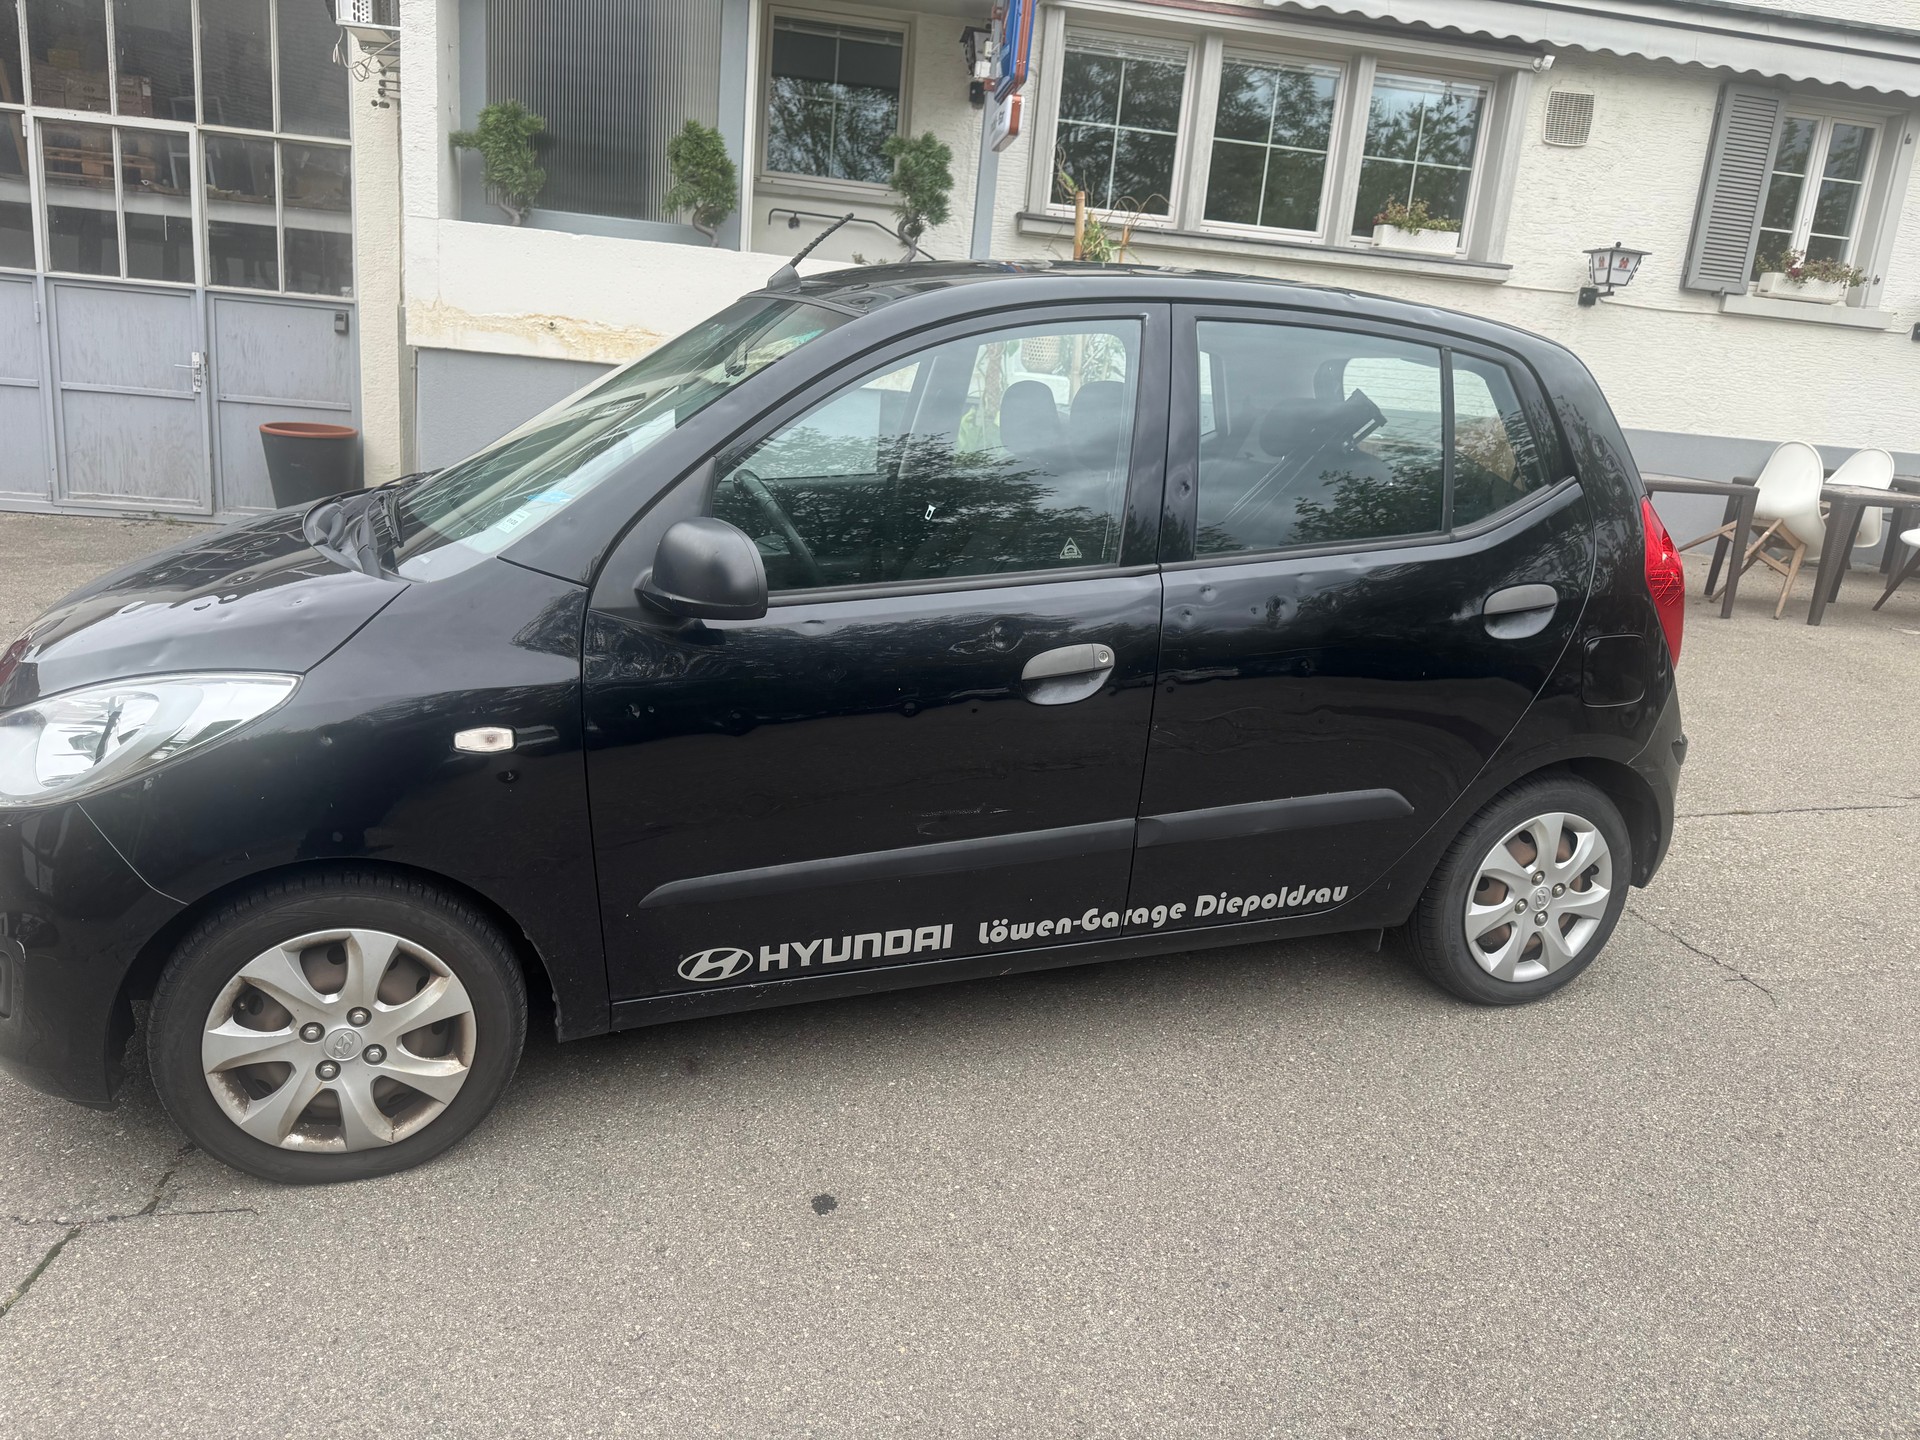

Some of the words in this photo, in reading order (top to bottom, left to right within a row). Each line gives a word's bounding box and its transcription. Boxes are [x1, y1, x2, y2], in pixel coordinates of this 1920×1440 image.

[758, 923, 954, 972] HYUNDAI
[978, 902, 1187, 944] Löwen-Garage
[1194, 884, 1349, 918] Diepoldsau
